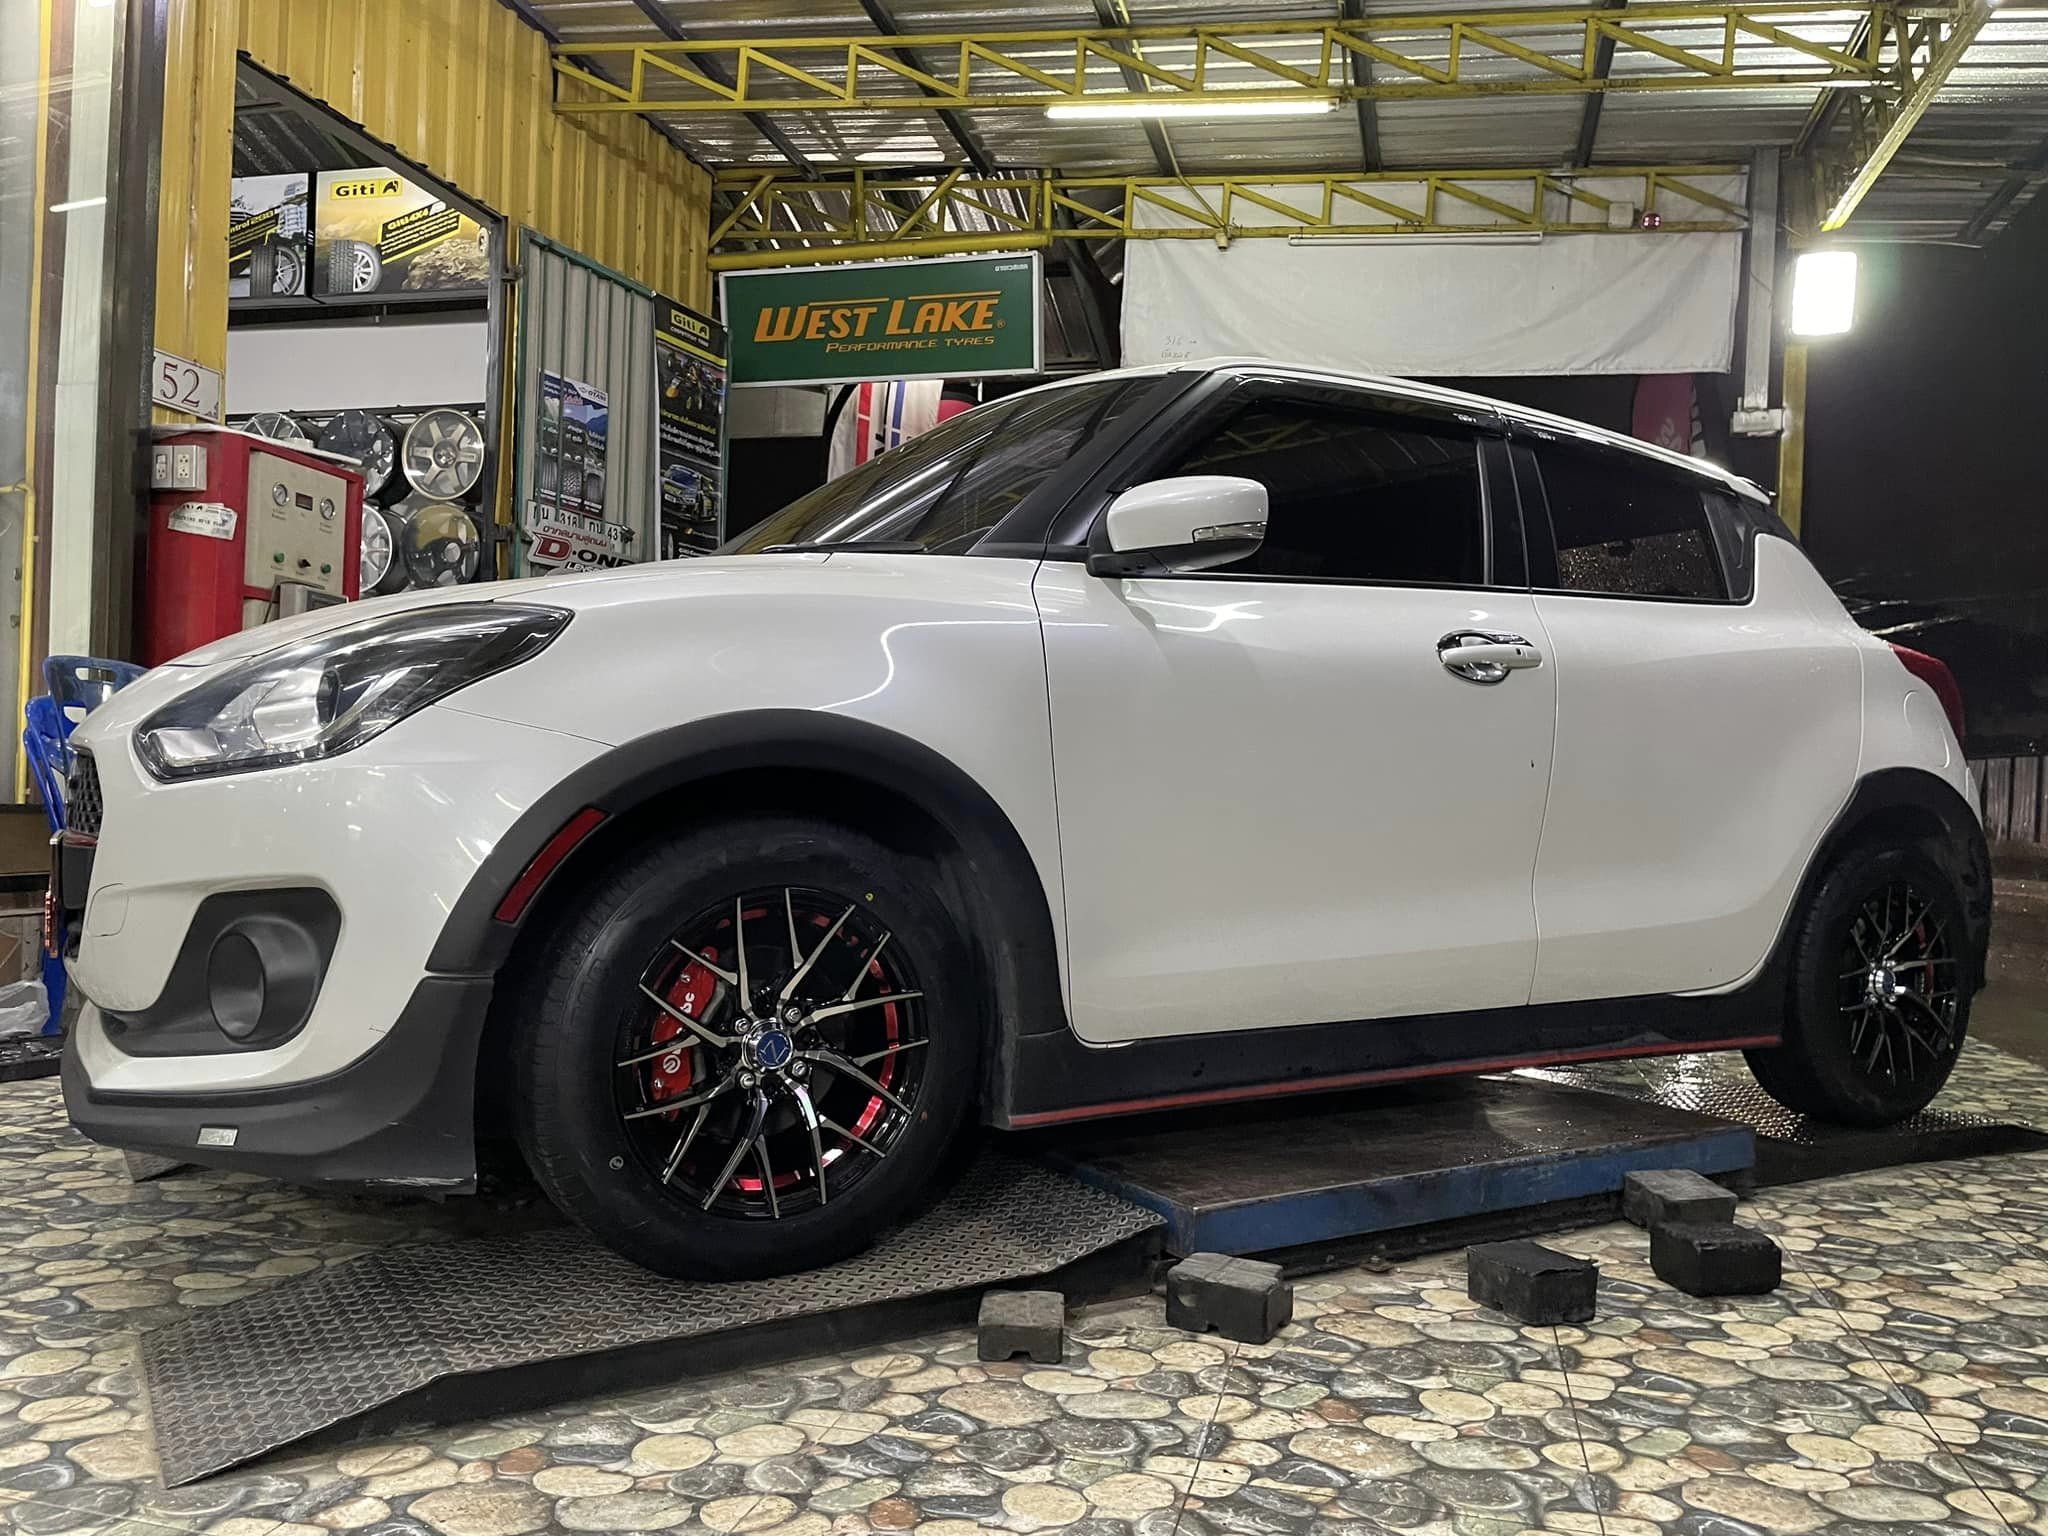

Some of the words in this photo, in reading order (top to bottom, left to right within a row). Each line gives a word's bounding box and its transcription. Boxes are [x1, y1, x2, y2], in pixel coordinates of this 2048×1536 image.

[336, 184, 375, 197] Giti
[673, 313, 696, 332] Giti
[754, 305, 878, 342] WEST
[885, 299, 999, 334] LAKE
[825, 339, 938, 353] PERFORMANCE
[943, 336, 995, 347] TYRES
[160, 361, 200, 408] 52
